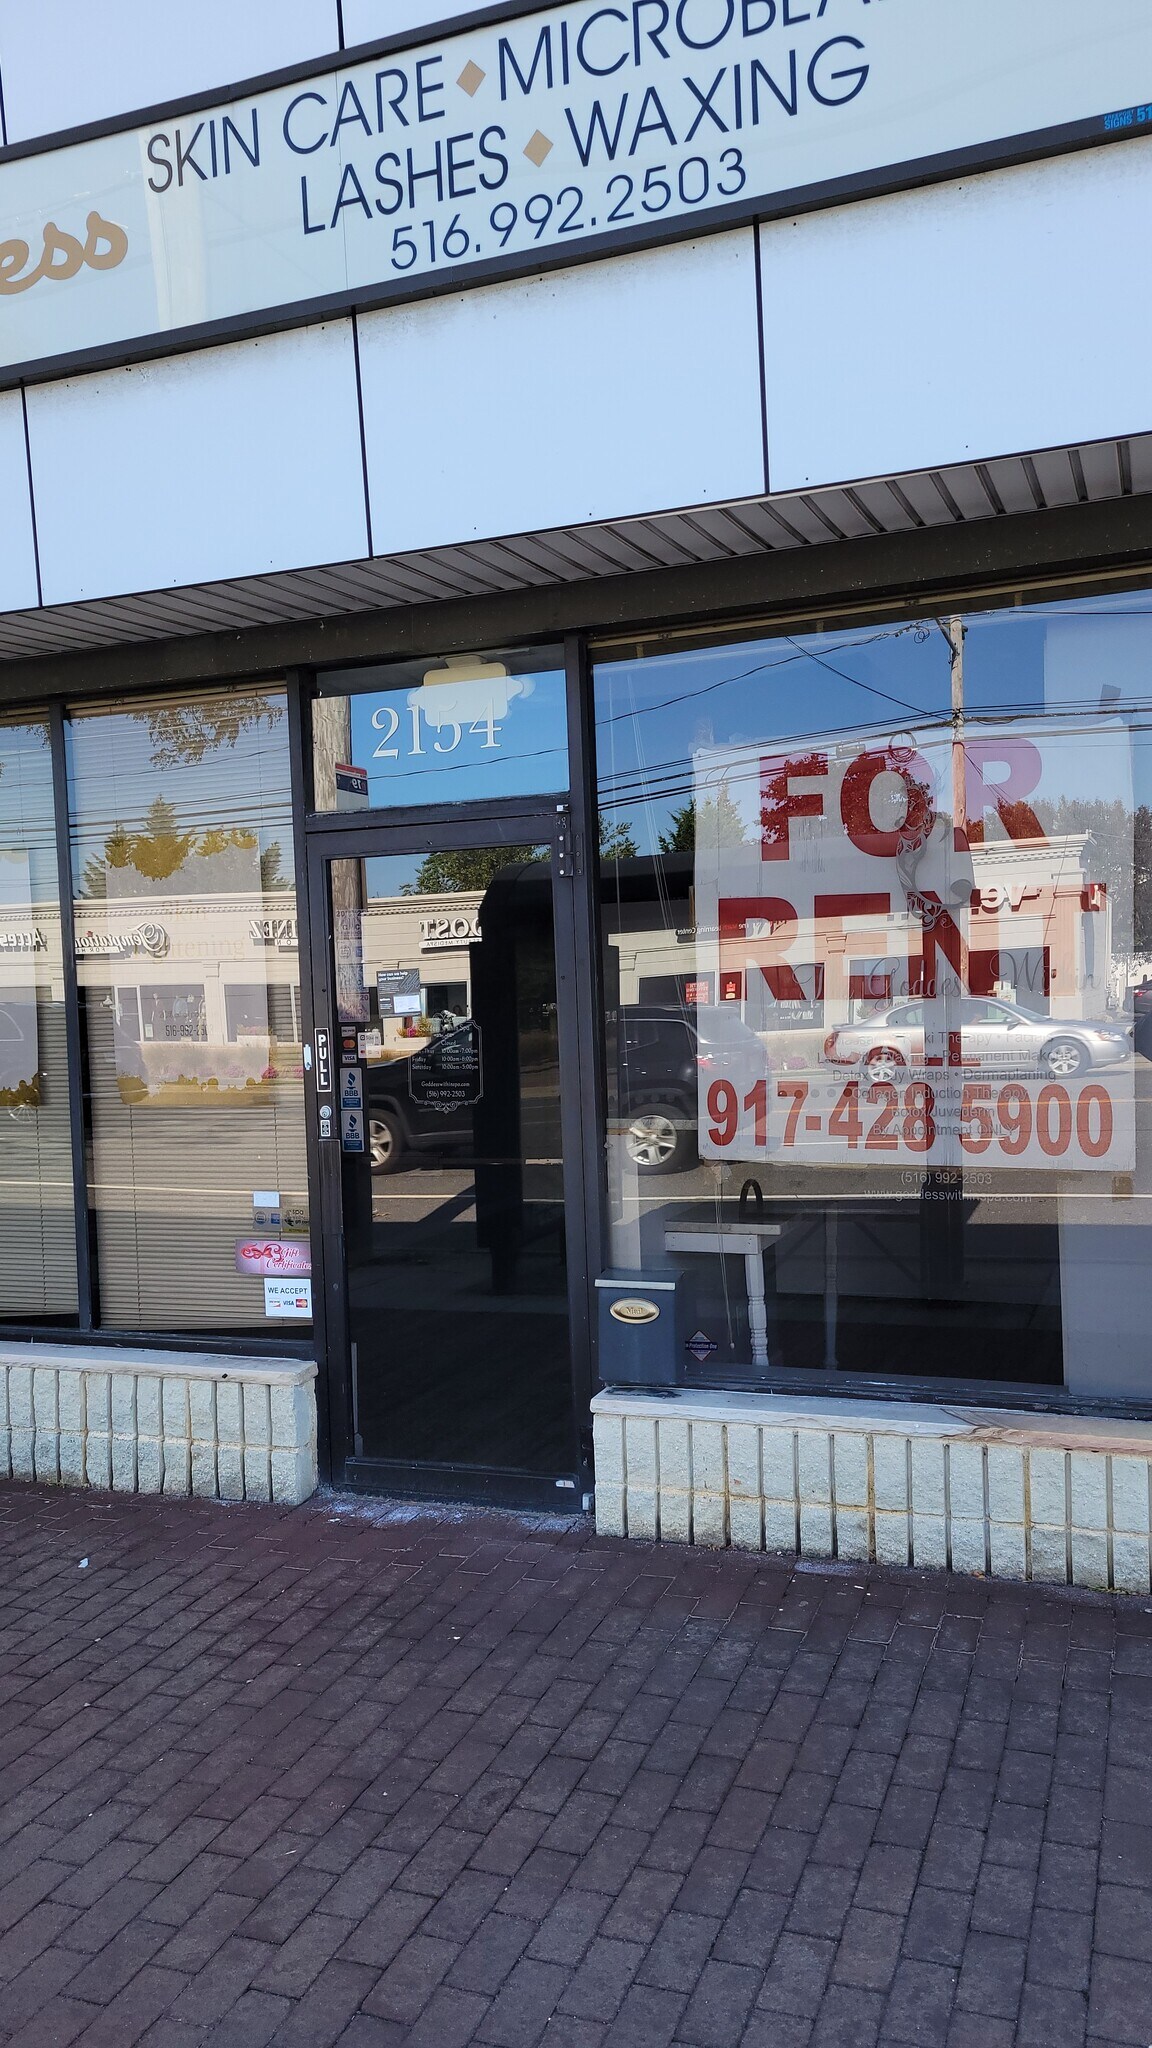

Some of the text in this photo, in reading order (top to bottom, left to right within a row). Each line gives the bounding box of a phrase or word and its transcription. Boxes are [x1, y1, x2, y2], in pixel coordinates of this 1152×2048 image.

[147, 107, 261, 194] SKIN
[282, 55, 446, 156] CARE
[1104, 114, 1133, 130] SIGNS
[300, 35, 871, 235] LASHES WAXING
[389, 147, 747, 271] 516.992.2503
[371, 697, 503, 760] 2154
[759, 736, 1051, 862] FOR
[718, 882, 1107, 1001] RENT
[317, 1034, 328, 1086] PULL
[942, 1050, 1015, 1062] Permanent
[832, 1069, 869, 1081] Detox
[908, 1068, 950, 1082] Wraps
[962, 1067, 1057, 1083] Dermaplaning
[344, 1089, 359, 1097] BBB
[426, 1090, 466, 1099] (516) 992-2503
[851, 1085, 1029, 1102] Collagen Induction Therapy
[873, 1122, 1016, 1139] By Appointment ONLY
[900, 1171, 993, 1185] (516) 992-2503
[281, 1246, 299, 1260] Gift
[268, 1286, 308, 1295] WE ACCEPT
